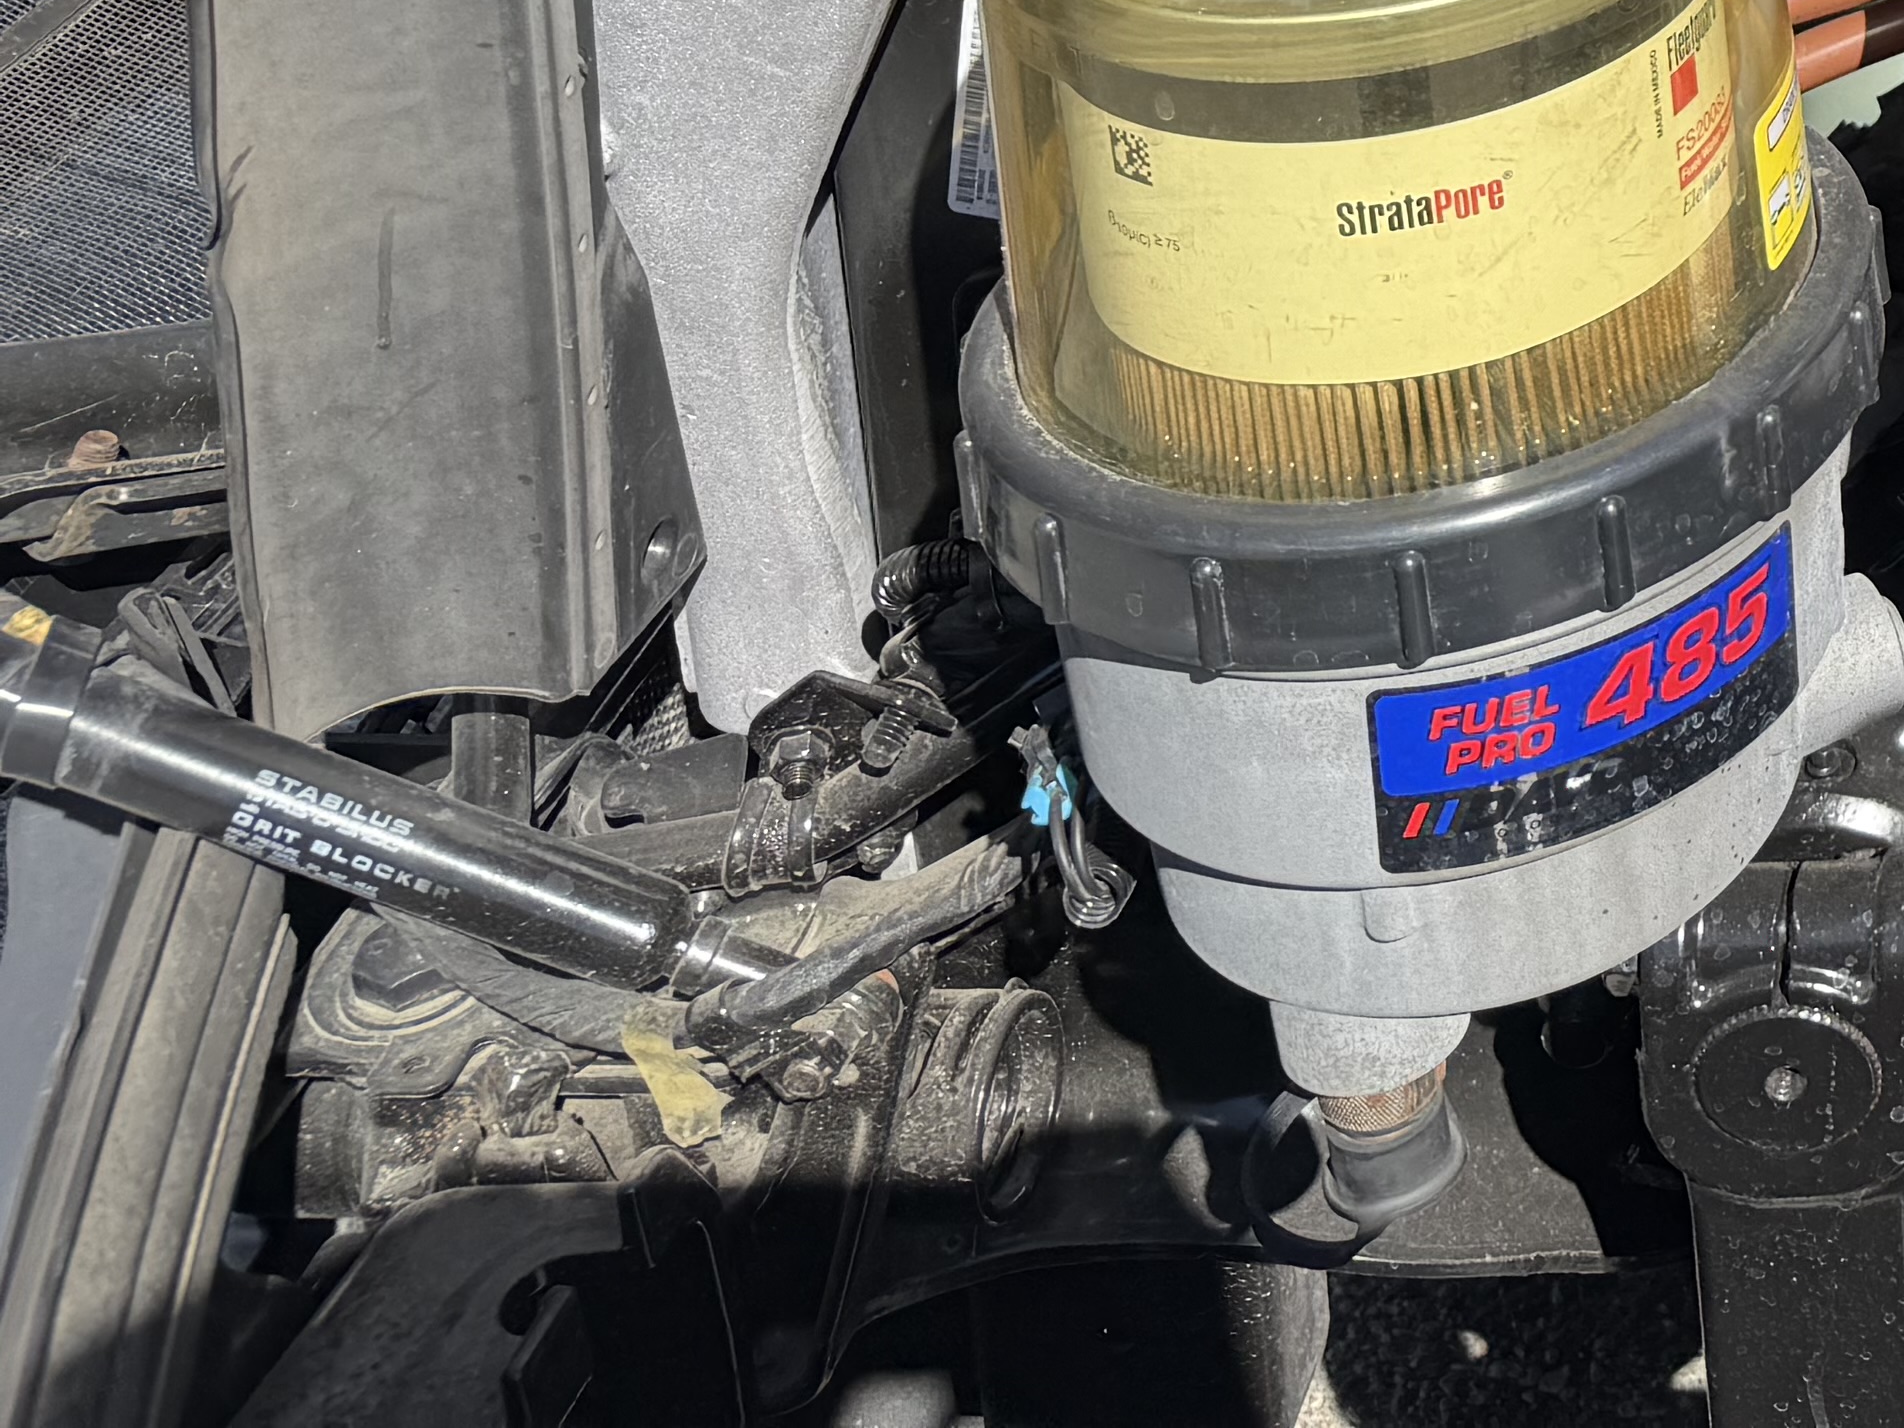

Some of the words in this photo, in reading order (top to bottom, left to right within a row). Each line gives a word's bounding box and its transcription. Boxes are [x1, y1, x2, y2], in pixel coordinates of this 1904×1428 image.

[1648, 49, 1659, 92] MEXICO
[1654, 106, 1664, 140] MADE
[1165, 237, 1181, 253] 75
[1584, 562, 1771, 730] 485
[1428, 684, 1560, 741] FUEL
[1445, 722, 1557, 776] PRO
[255, 769, 415, 836] STABILUS
[311, 839, 451, 900] BLOCKER
